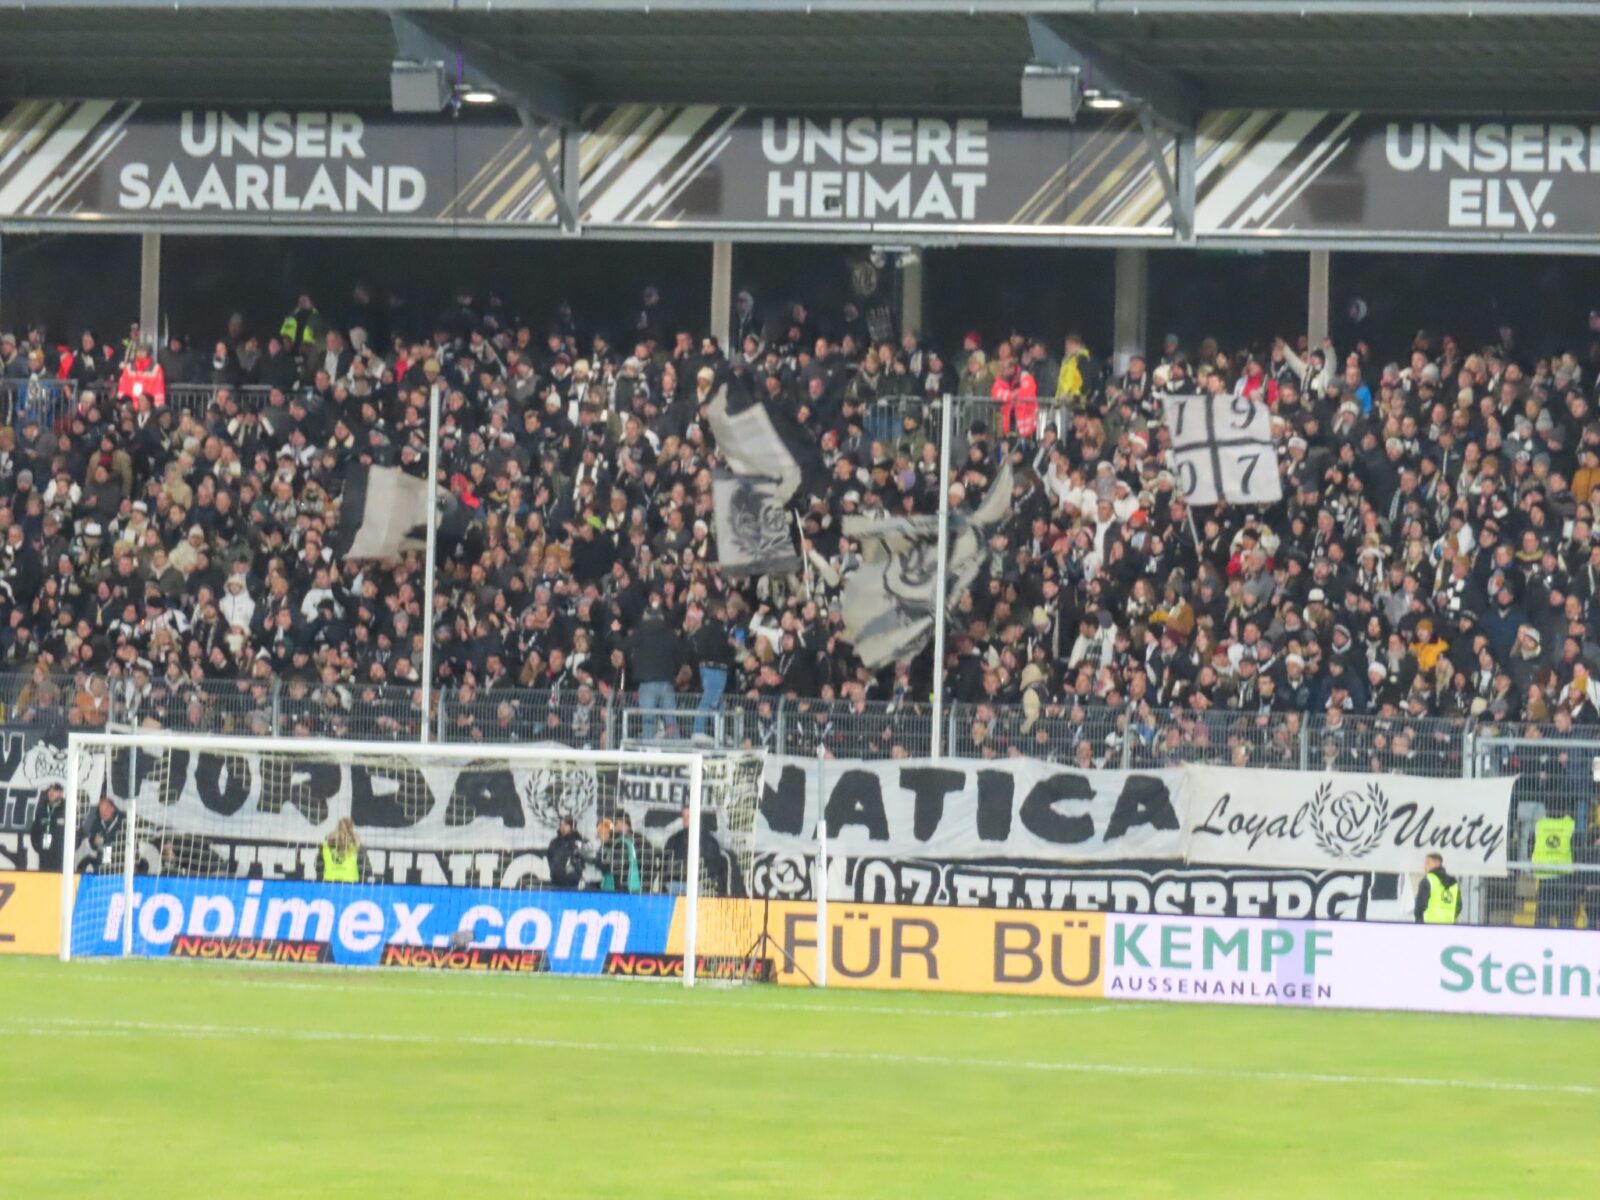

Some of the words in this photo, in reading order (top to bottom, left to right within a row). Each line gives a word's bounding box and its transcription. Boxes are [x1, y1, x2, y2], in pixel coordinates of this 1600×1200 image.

[180, 110, 366, 160] UNSER
[761, 117, 989, 166] UNSERE
[118, 162, 427, 213] SAARLAND
[766, 170, 988, 221] HEIMAT
[1448, 178, 1557, 234] ELV.
[1191, 792, 1310, 852] Loyal
[1388, 801, 1504, 863] Unity
[103, 879, 631, 961] ropimex.com
[782, 911, 940, 981] FÜR
[1113, 922, 1333, 976] KEMPF
[1439, 944, 1600, 997] Stein
[1111, 975, 1332, 999] AUSSENANLAGEN
